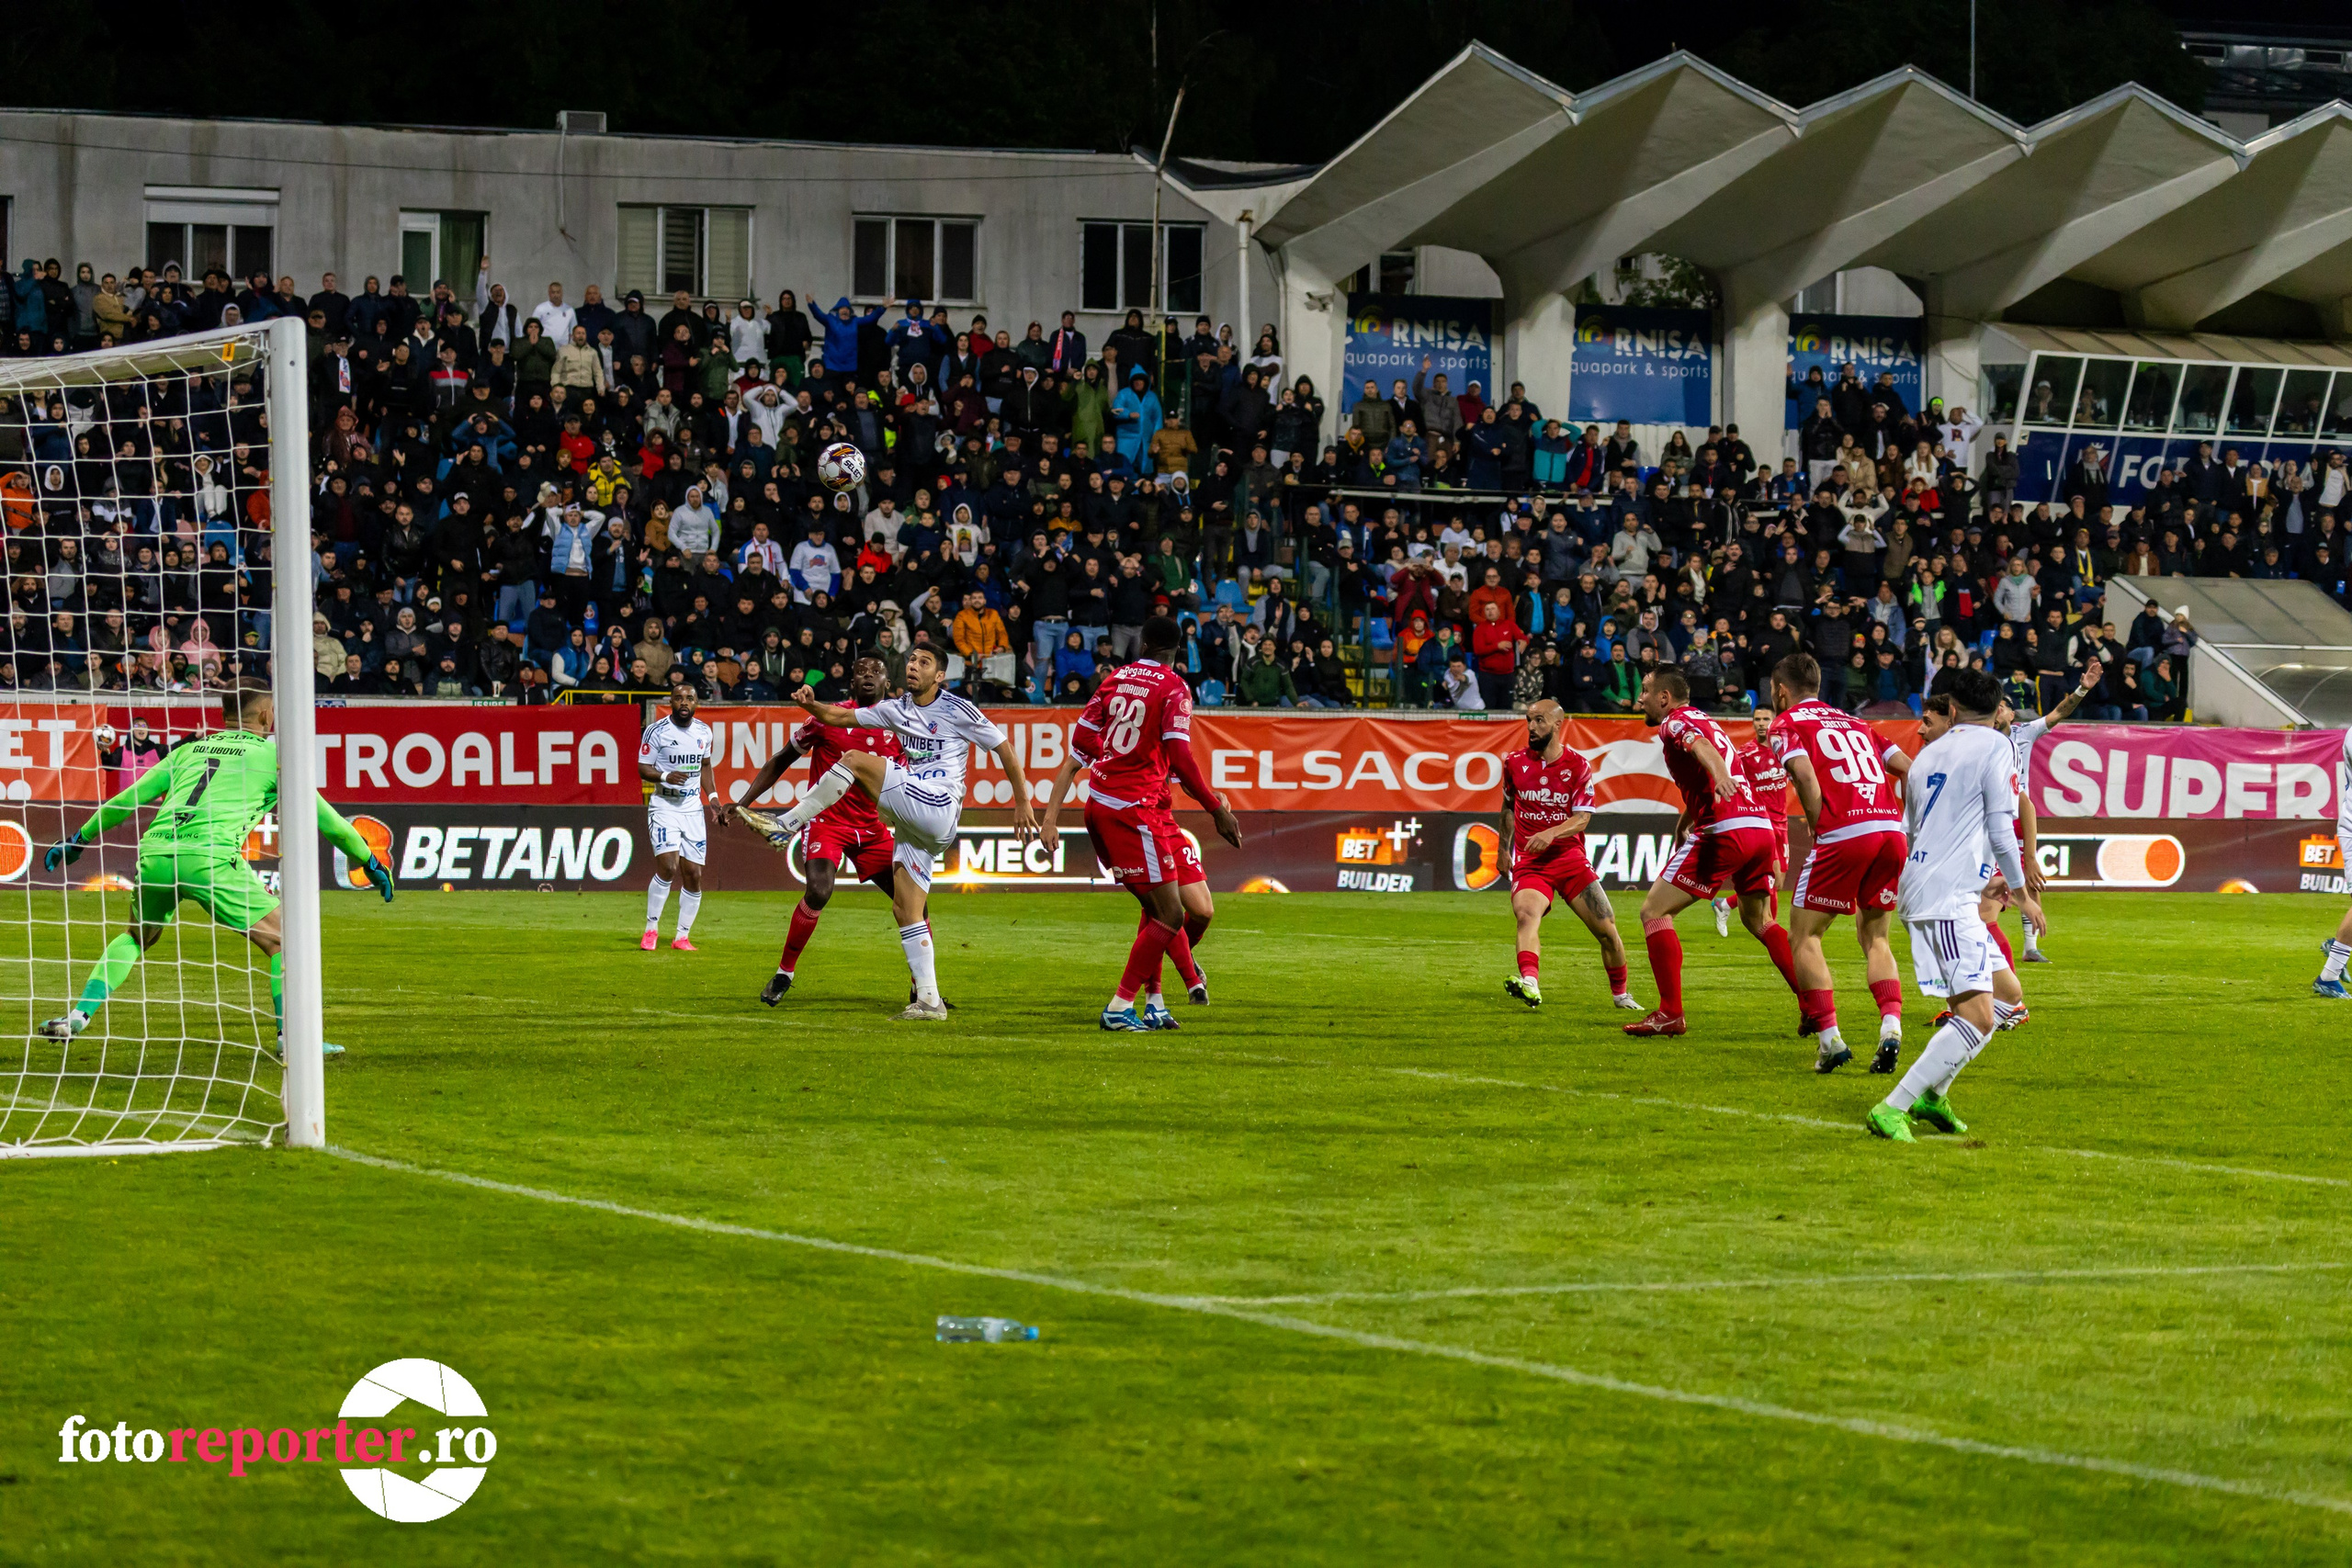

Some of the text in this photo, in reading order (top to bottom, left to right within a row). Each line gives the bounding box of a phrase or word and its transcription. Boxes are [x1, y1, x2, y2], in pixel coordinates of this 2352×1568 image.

[1440, 355, 1488, 371] sports
[1645, 363, 1655, 376] &
[1661, 363, 1709, 378] sports
[1874, 371, 1918, 384] sorts
[843, 460, 862, 479] SELECT
[902, 736, 945, 750] UNIBET
[1816, 728, 1884, 784] 98
[1211, 749, 1503, 791] ELSACO
[1755, 766, 1787, 781] WIN2.R
[2043, 740, 2345, 819] SUPER
[662, 787, 700, 796] ELSAC
[1920, 773, 1947, 828] 7
[1866, 807, 1898, 816] GAMING
[400, 826, 635, 881] BETANO
[959, 840, 1064, 874] MECI
[1341, 839, 1379, 859] BET
[2303, 844, 2335, 863] BET
[1337, 870, 1414, 892] BUILDER
[1807, 895, 1850, 909] CARPATINA
